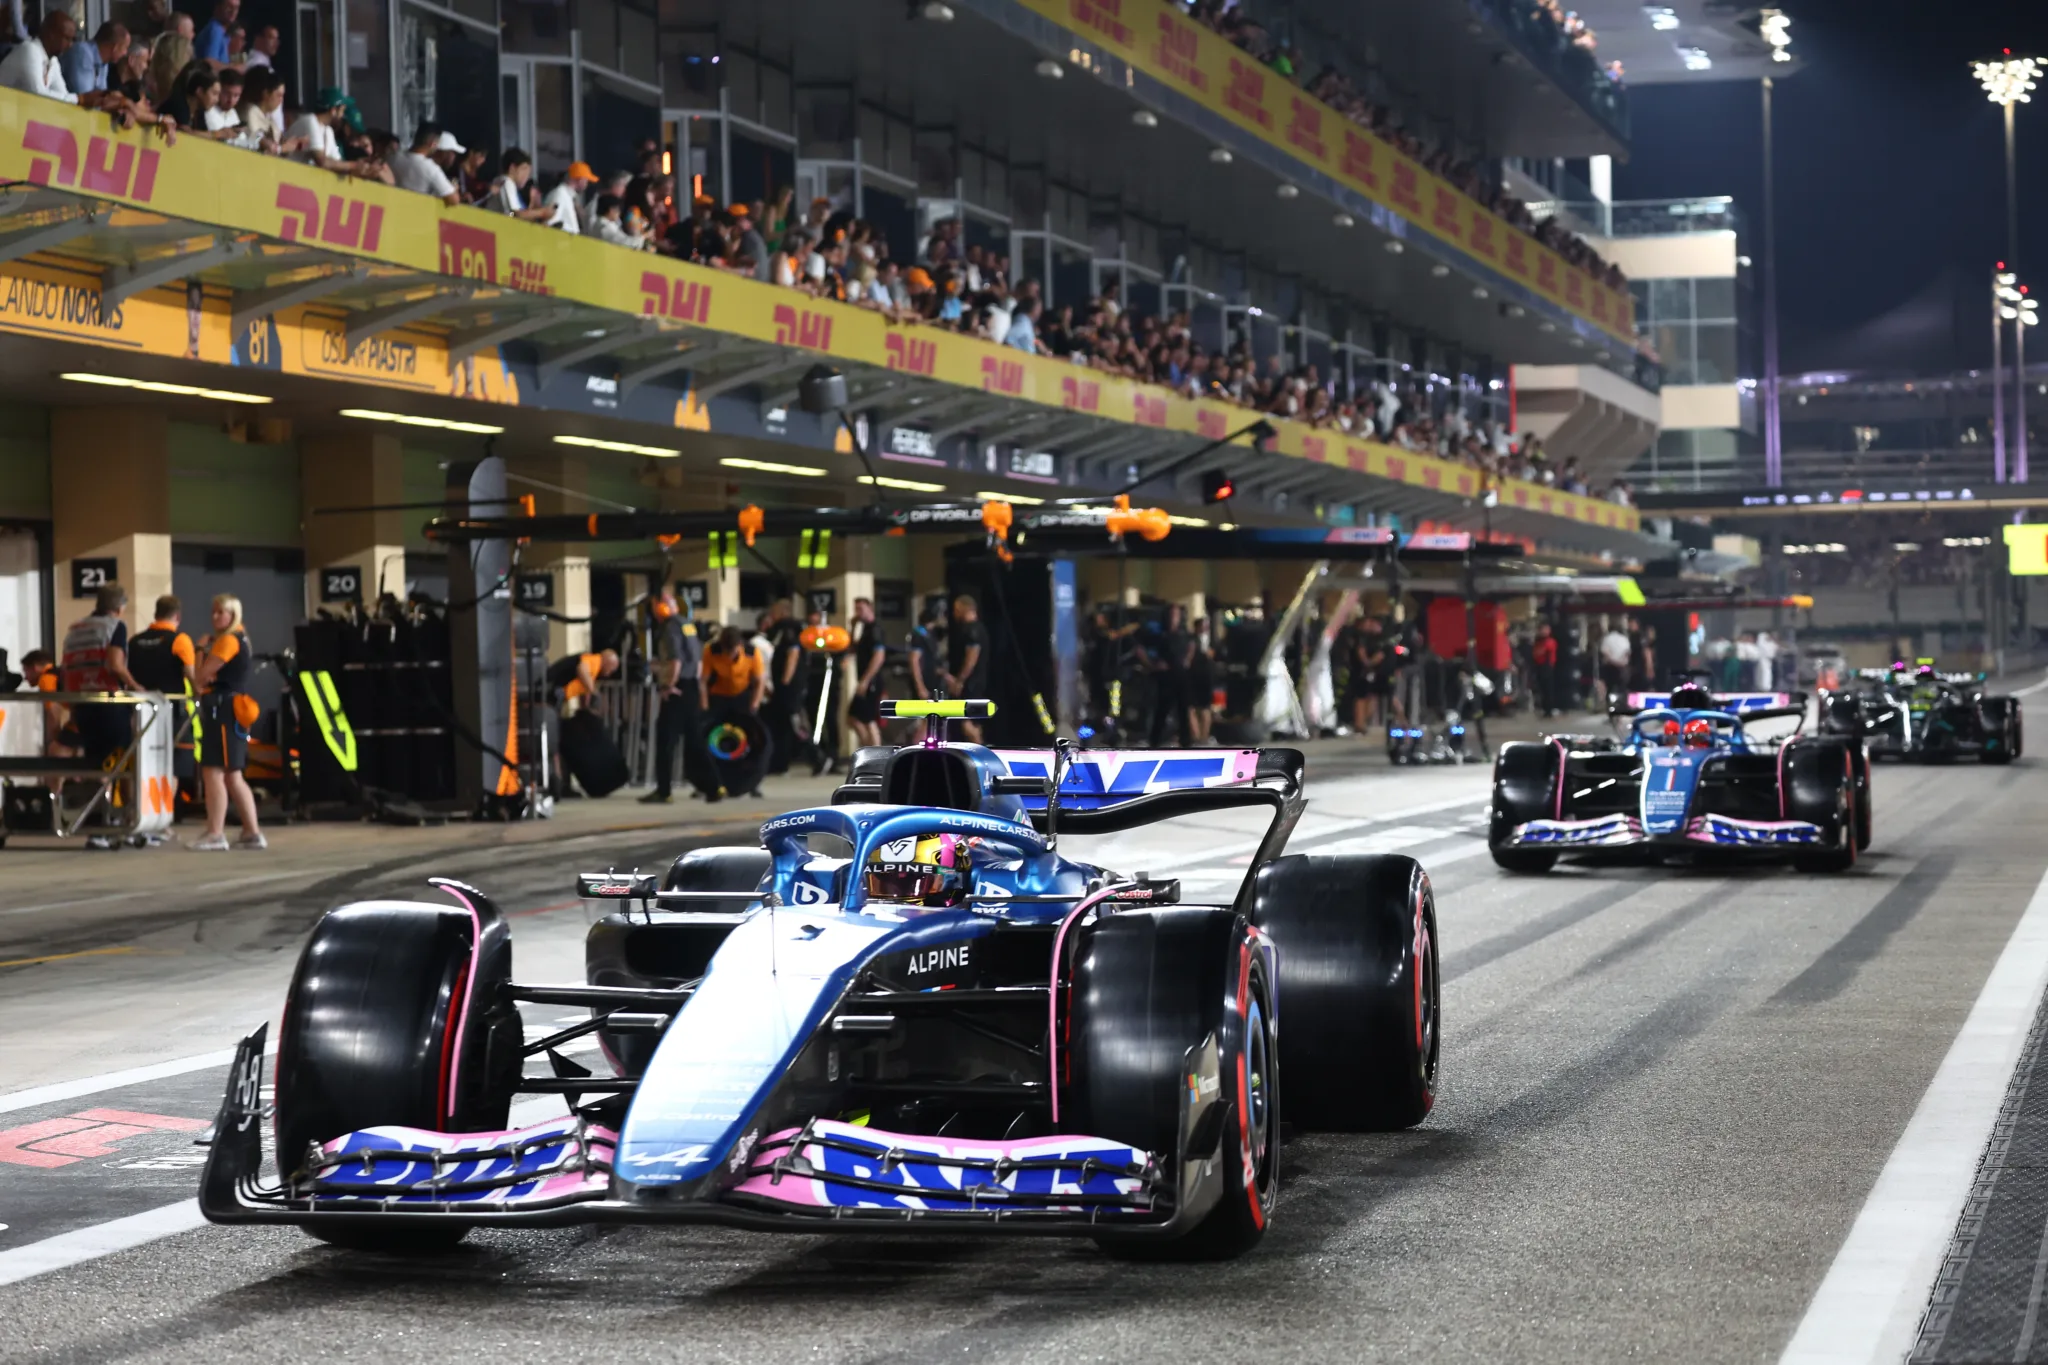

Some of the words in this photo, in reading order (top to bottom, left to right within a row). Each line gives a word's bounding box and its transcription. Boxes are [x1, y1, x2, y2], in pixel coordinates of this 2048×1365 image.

[910, 509, 932, 522] DP
[932, 508, 984, 521] WORLD
[80, 567, 107, 588] 21
[327, 575, 356, 594] 20
[522, 581, 548, 599] 19
[863, 864, 934, 875] ALPINE
[907, 946, 969, 976] ALPINE
